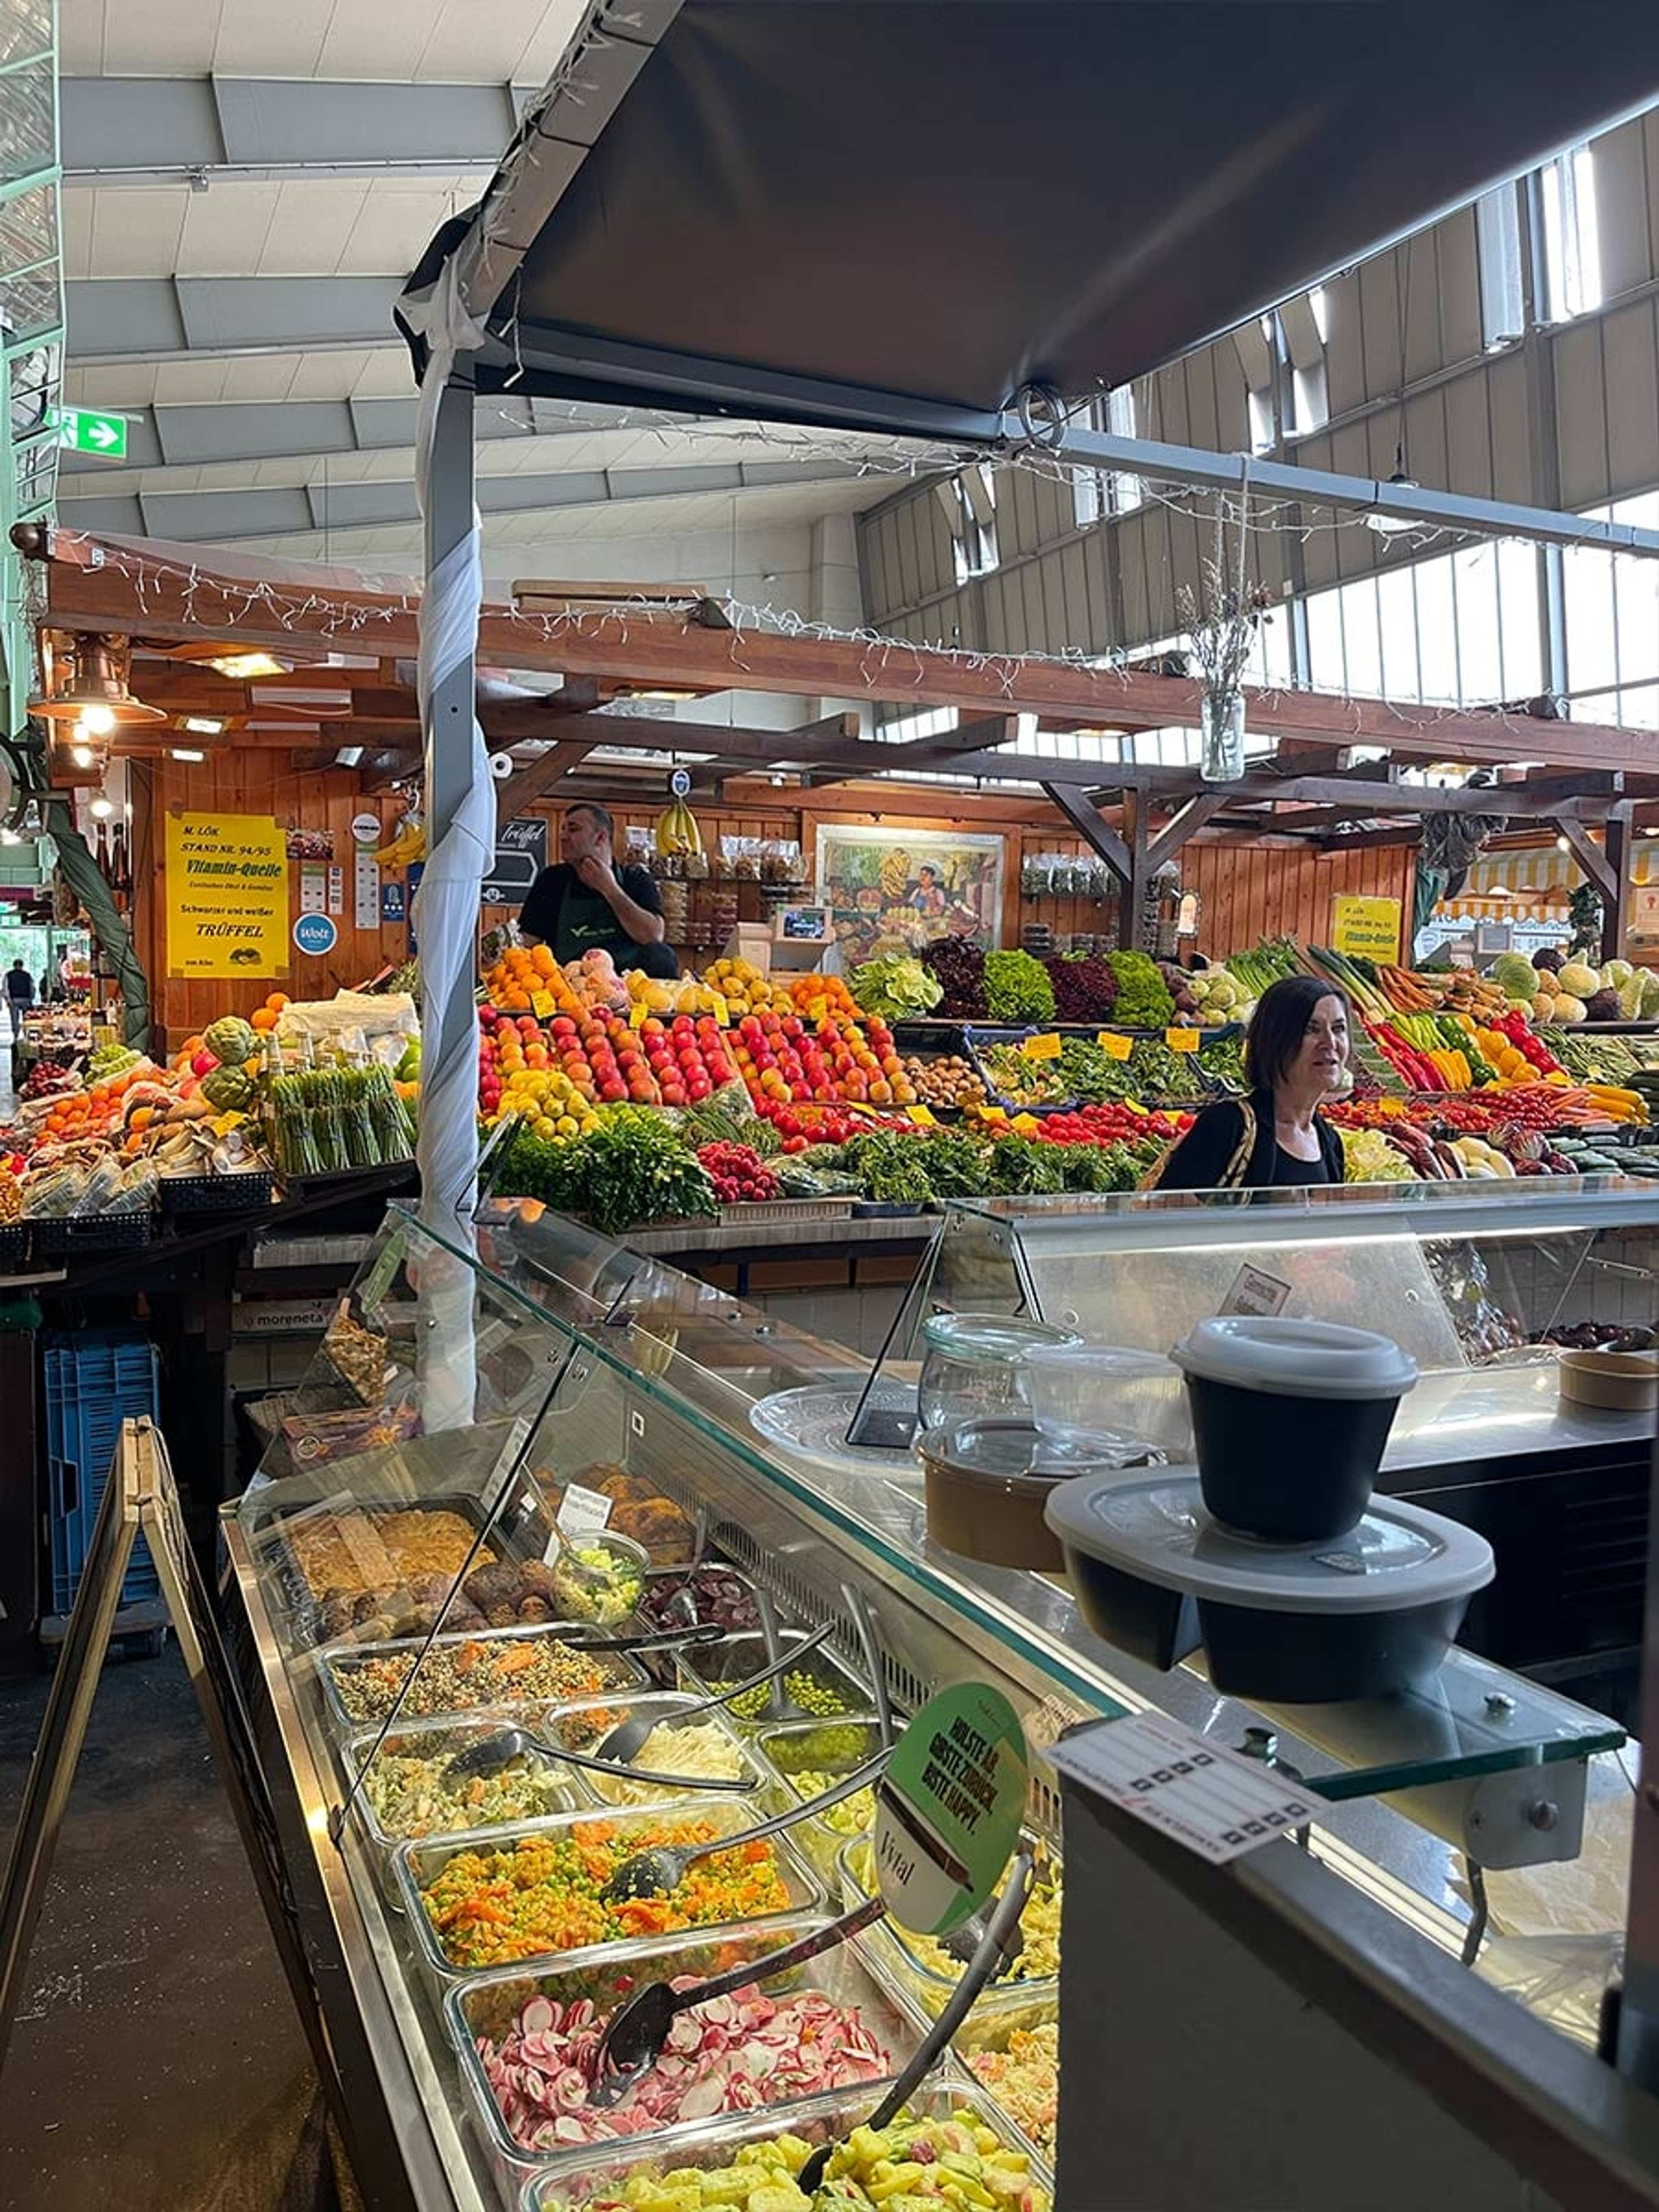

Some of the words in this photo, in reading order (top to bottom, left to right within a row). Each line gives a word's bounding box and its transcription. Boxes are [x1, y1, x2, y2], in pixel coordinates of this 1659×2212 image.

[181, 843, 218, 852] STAND
[239, 846, 272, 856] 94/95
[187, 859, 282, 877] Vitamin-Quelle
[181, 904, 225, 915] Schwarzer
[197, 922, 263, 938] TRÜFFEL
[301, 928, 328, 939] Wolt
[881, 1830, 915, 1885] Vytal
